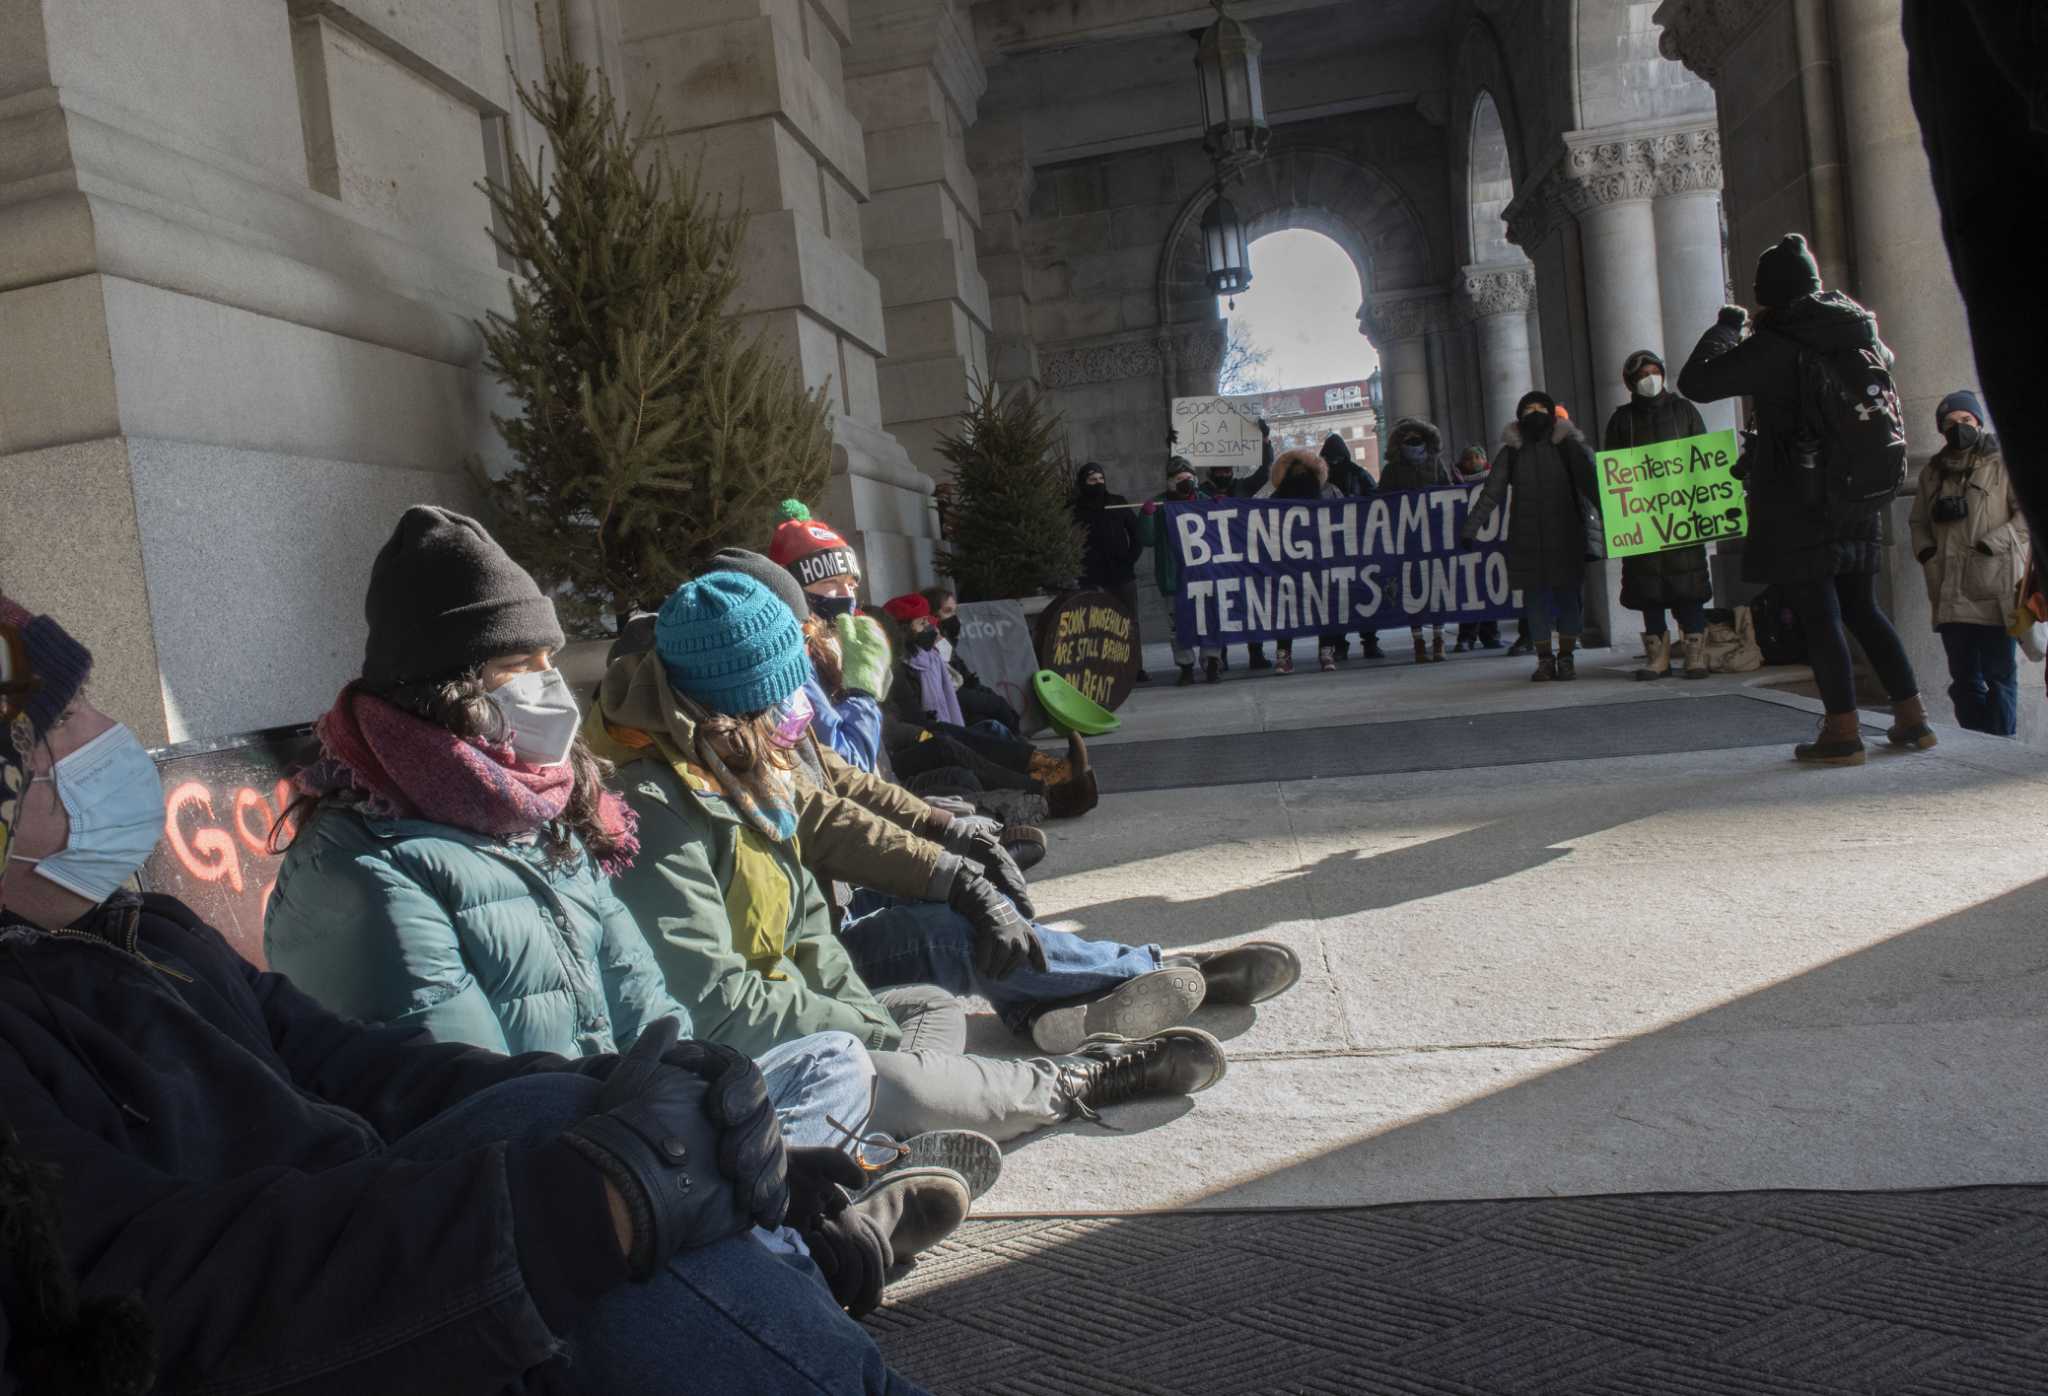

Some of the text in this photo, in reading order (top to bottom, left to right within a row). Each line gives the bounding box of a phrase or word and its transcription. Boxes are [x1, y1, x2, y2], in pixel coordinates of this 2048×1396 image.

[1175, 400, 1215, 416] GOOD
[1195, 420, 1229, 435] IS A
[1175, 439, 1260, 455] GOOD START
[1604, 445, 1728, 485] Renters Are
[1609, 481, 1732, 517] Taxpayers
[1612, 511, 1740, 547] and Voters
[800, 552, 847, 583] HOME
[1187, 552, 1523, 635] TENANTS UNIO
[1054, 637, 1131, 665] ARE STILL BEHIND
[1081, 668, 1116, 704] RENT
